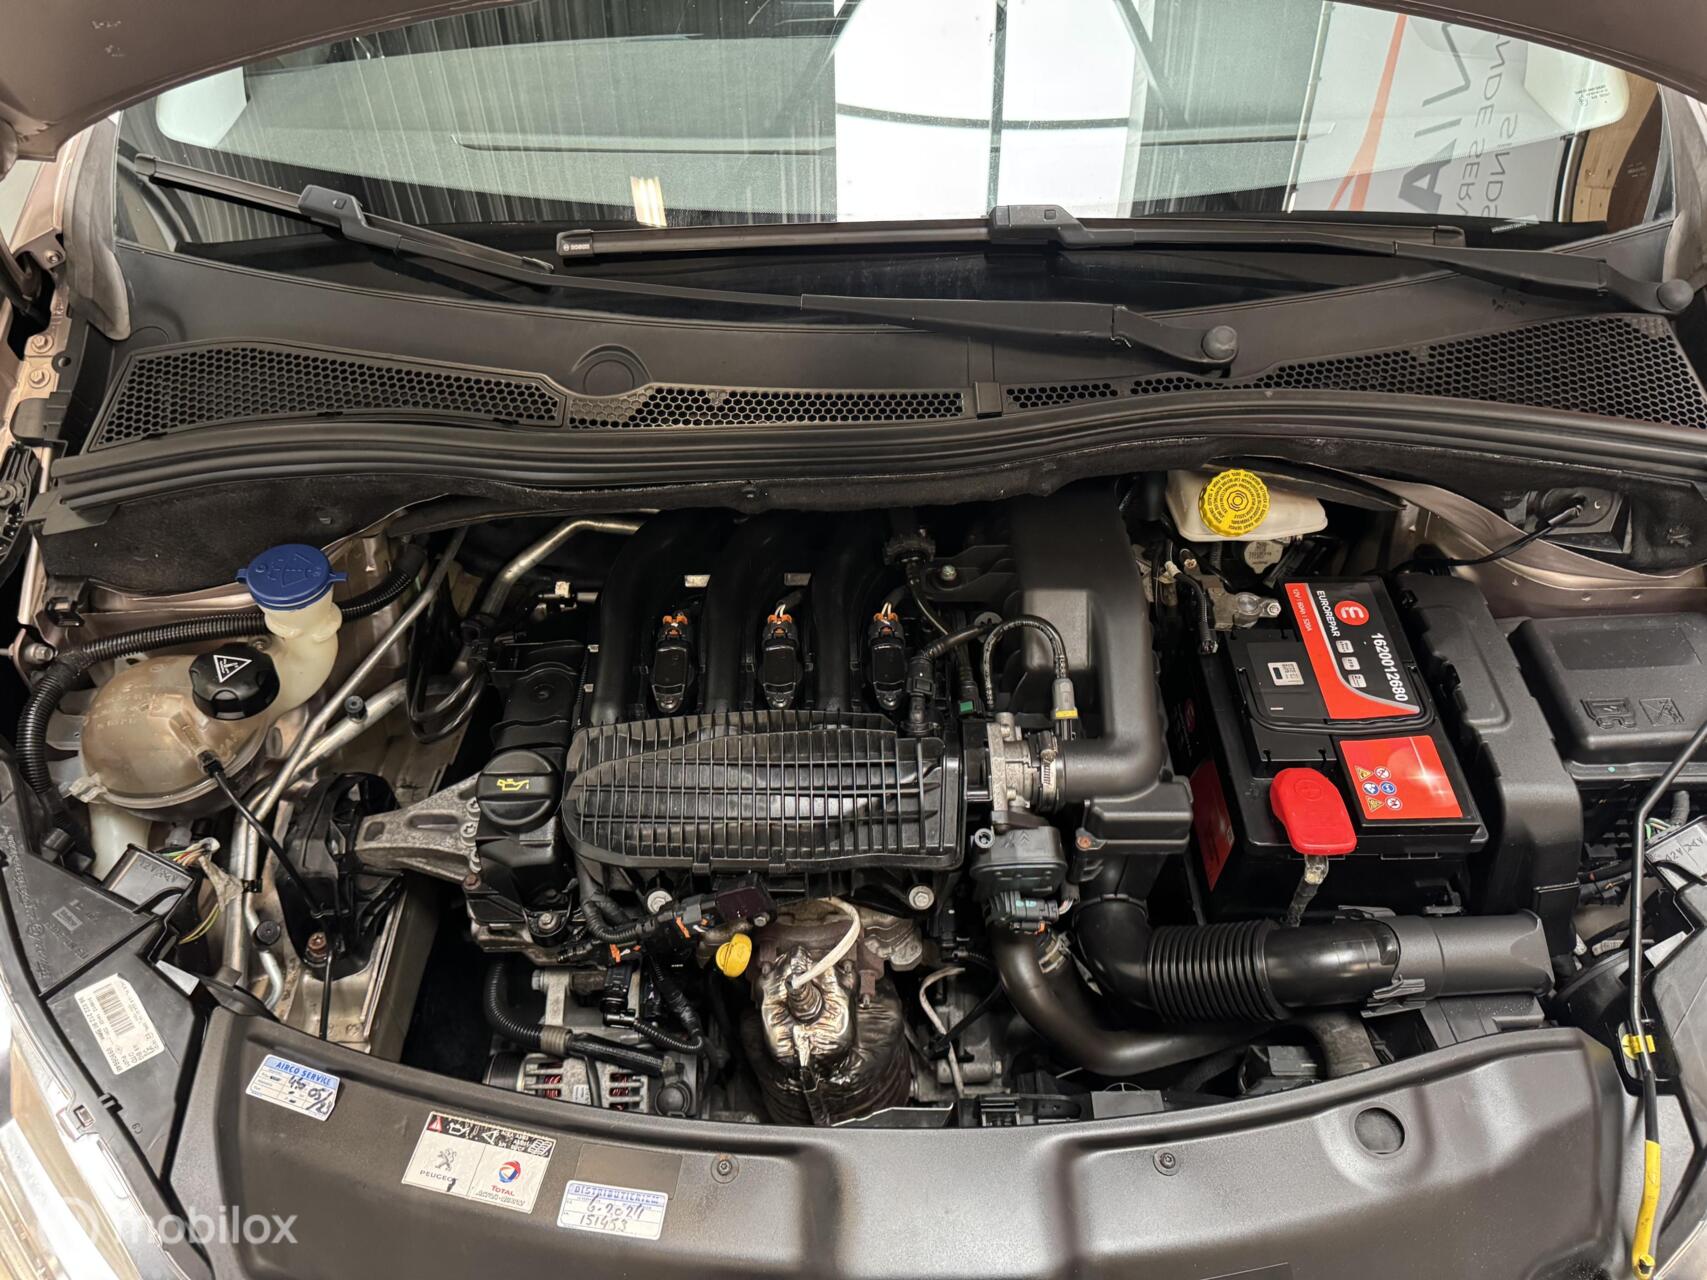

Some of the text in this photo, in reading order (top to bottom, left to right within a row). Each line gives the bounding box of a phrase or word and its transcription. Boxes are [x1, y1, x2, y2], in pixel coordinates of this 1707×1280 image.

[1316, 590, 1341, 637] EUROREPAR
[1371, 632, 1408, 702] 1620012680
[276, 1062, 301, 1075] AIRCO
[301, 1070, 332, 1087] SERVICE
[420, 1169, 458, 1181] PEUGEOT
[491, 1184, 515, 1197] TOTAL
